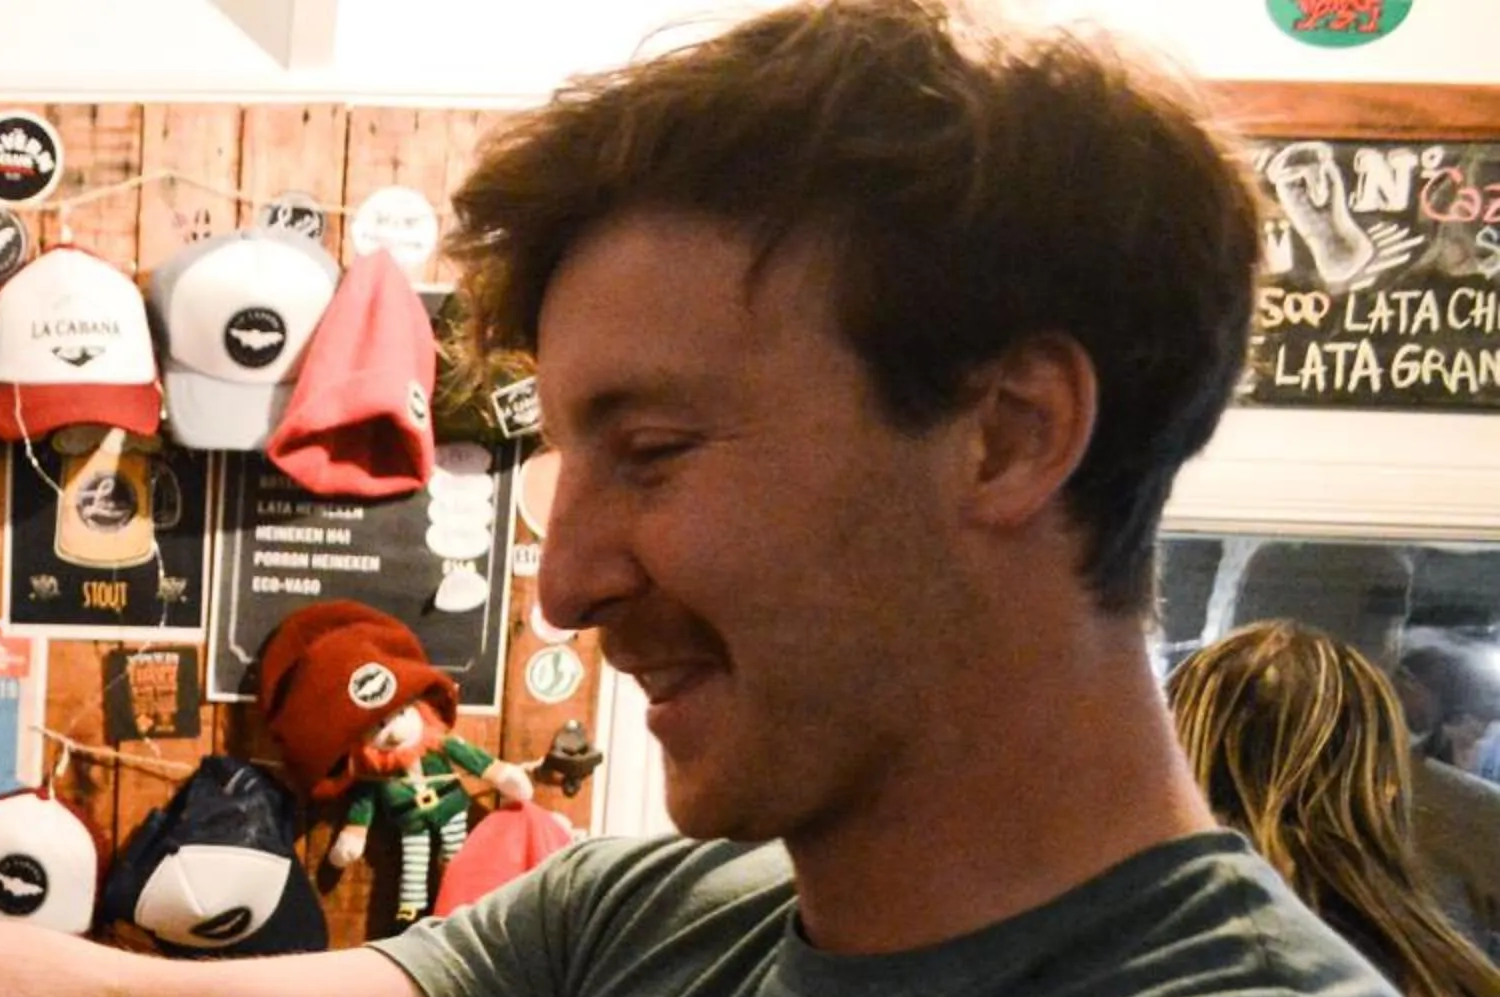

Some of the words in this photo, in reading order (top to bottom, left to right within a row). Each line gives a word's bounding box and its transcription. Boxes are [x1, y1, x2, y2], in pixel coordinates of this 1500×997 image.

[1343, 290, 1441, 335] LATA
[1447, 287, 1500, 334] CH
[1274, 338, 1384, 393] LATA
[82, 580, 128, 609] STOUT
